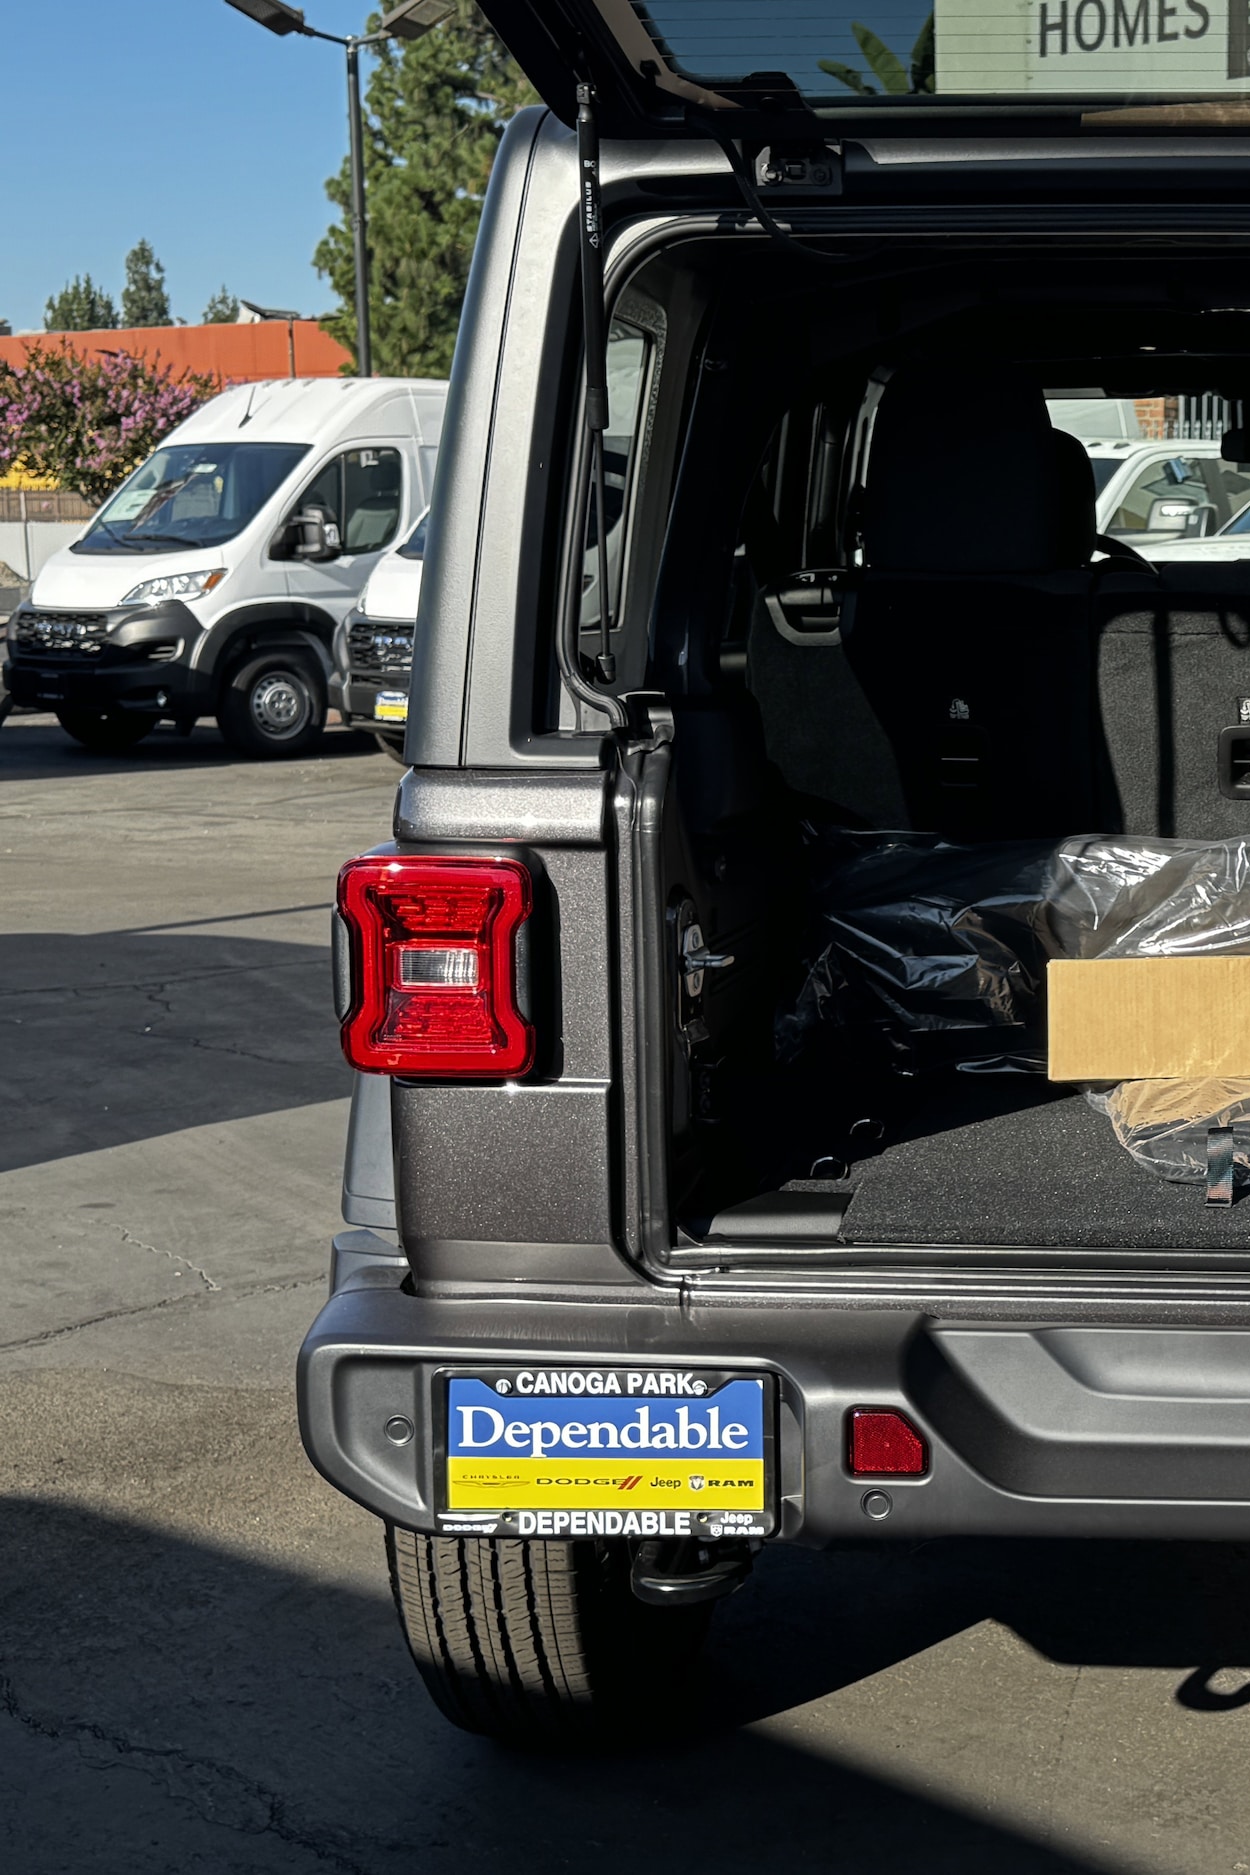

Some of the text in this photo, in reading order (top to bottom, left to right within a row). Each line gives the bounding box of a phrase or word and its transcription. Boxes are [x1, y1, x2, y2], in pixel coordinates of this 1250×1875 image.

[1039, 0, 1209, 57] HOMES
[585, 181, 593, 232] STABILUS
[516, 1371, 694, 1395] CANOGA PARK
[456, 1405, 749, 1458] Dependable
[650, 1476, 681, 1489] Jeep
[518, 1511, 692, 1536] DEPENDABLE
[720, 1511, 754, 1525] Jeep
